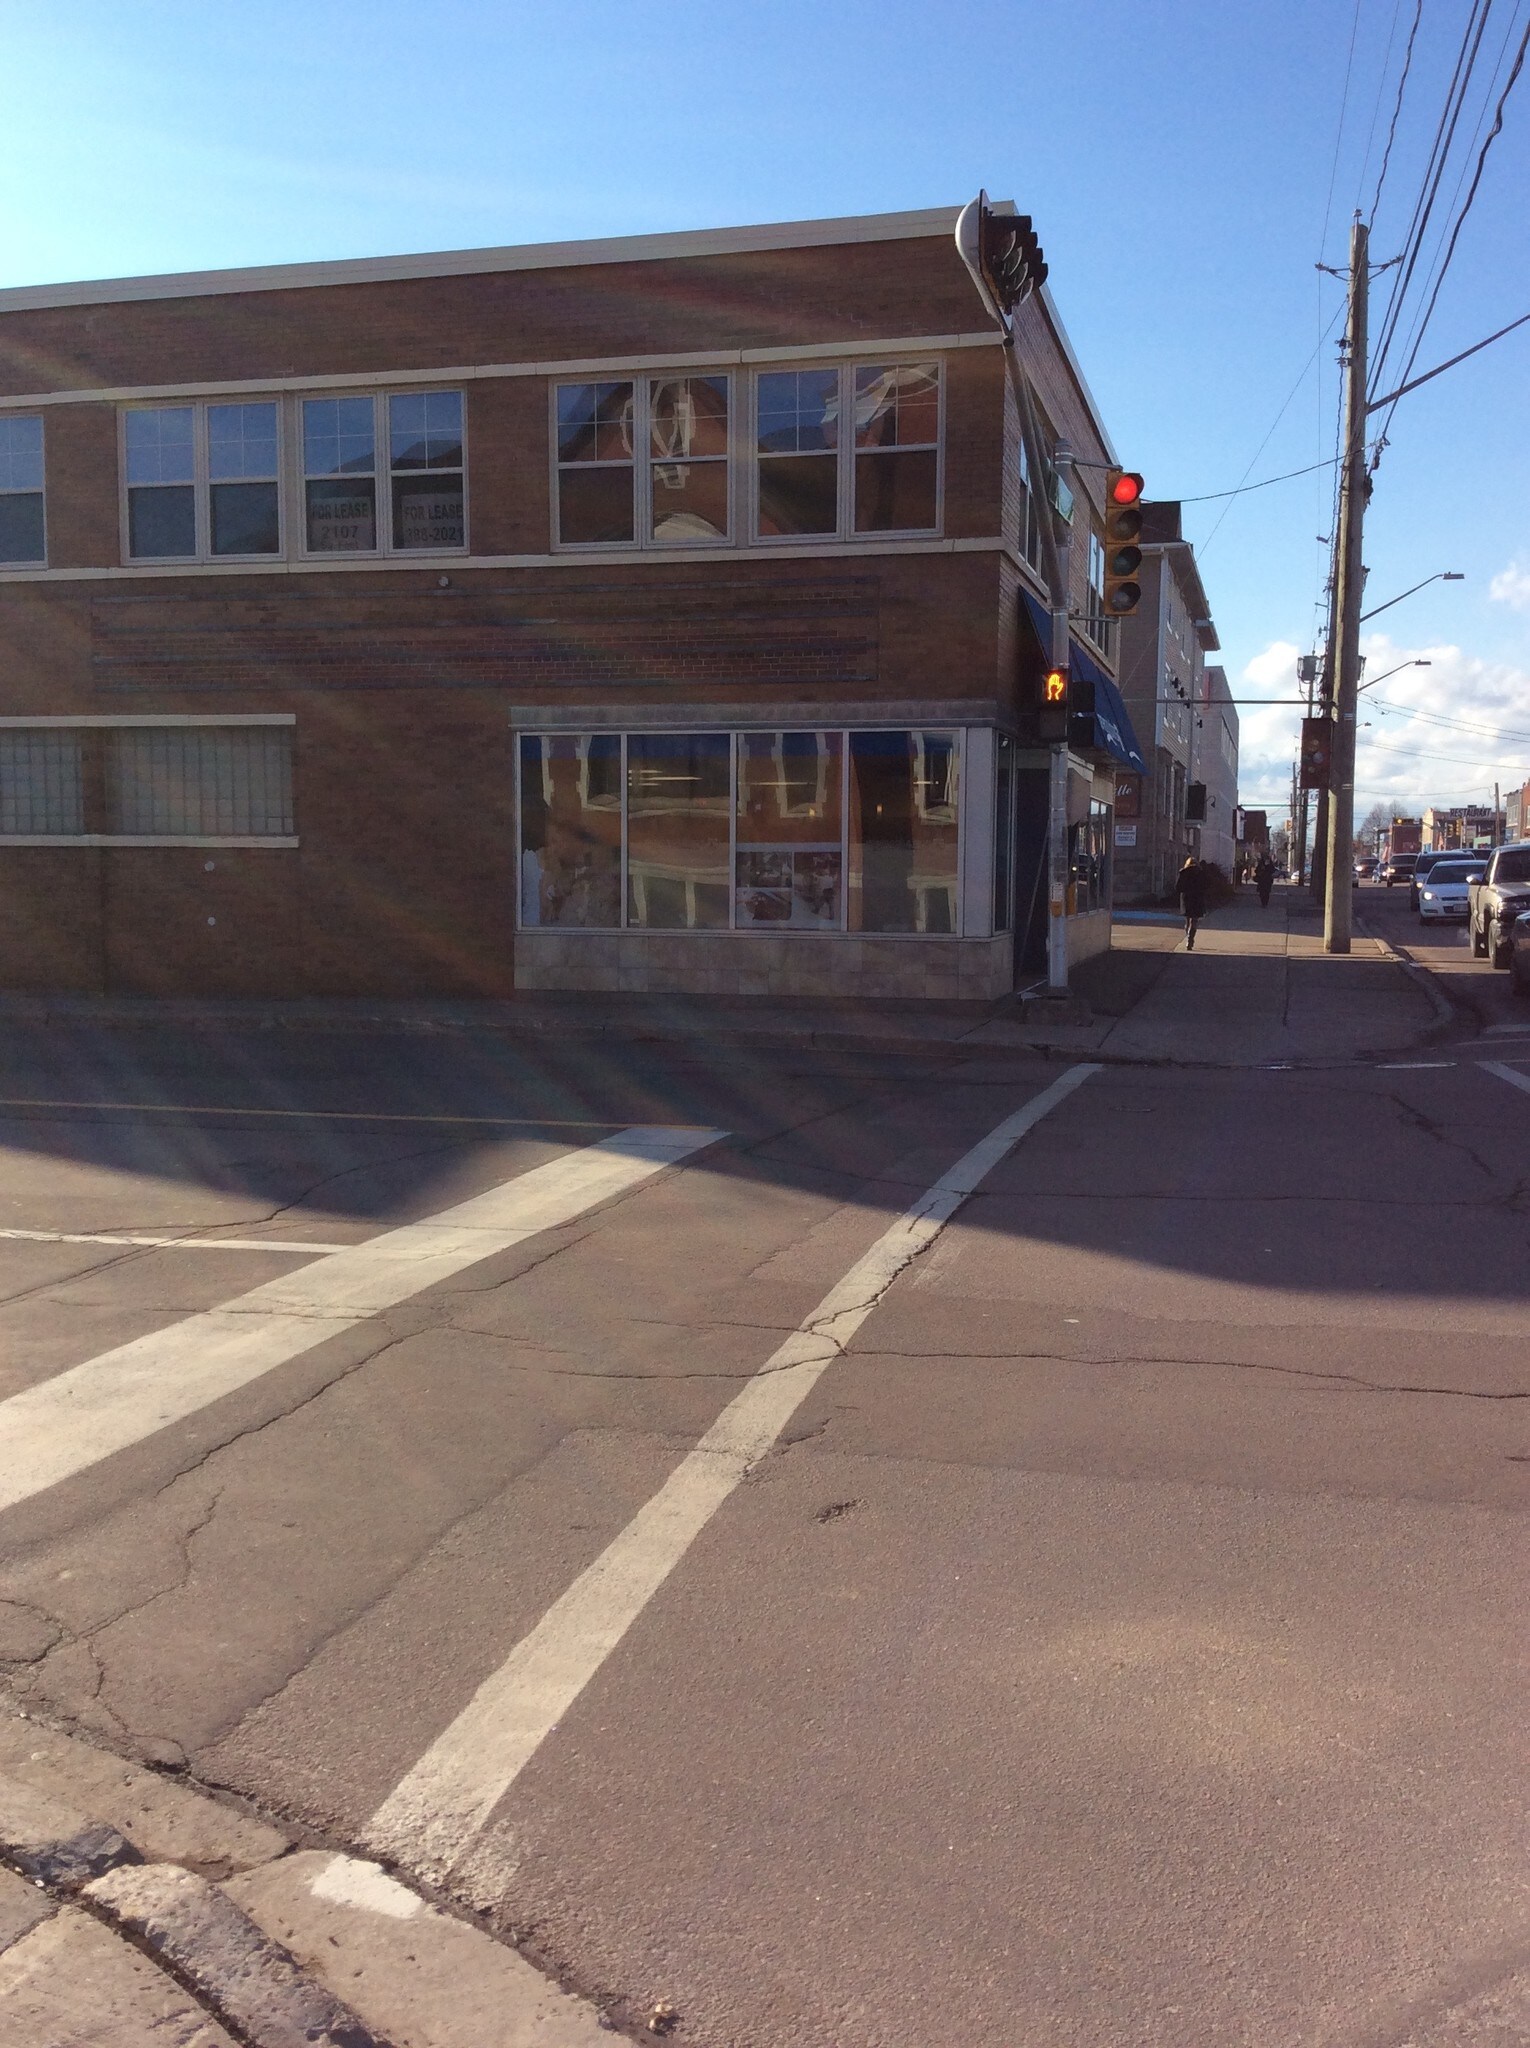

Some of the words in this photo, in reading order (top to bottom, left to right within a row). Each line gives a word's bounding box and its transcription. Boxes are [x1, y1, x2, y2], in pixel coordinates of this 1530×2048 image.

[312, 503, 331, 519] FOR
[334, 502, 368, 519] LEASE
[405, 505, 425, 520] FOR
[428, 503, 463, 520] LEASE
[1450, 808, 1491, 818] RESTAURANT
